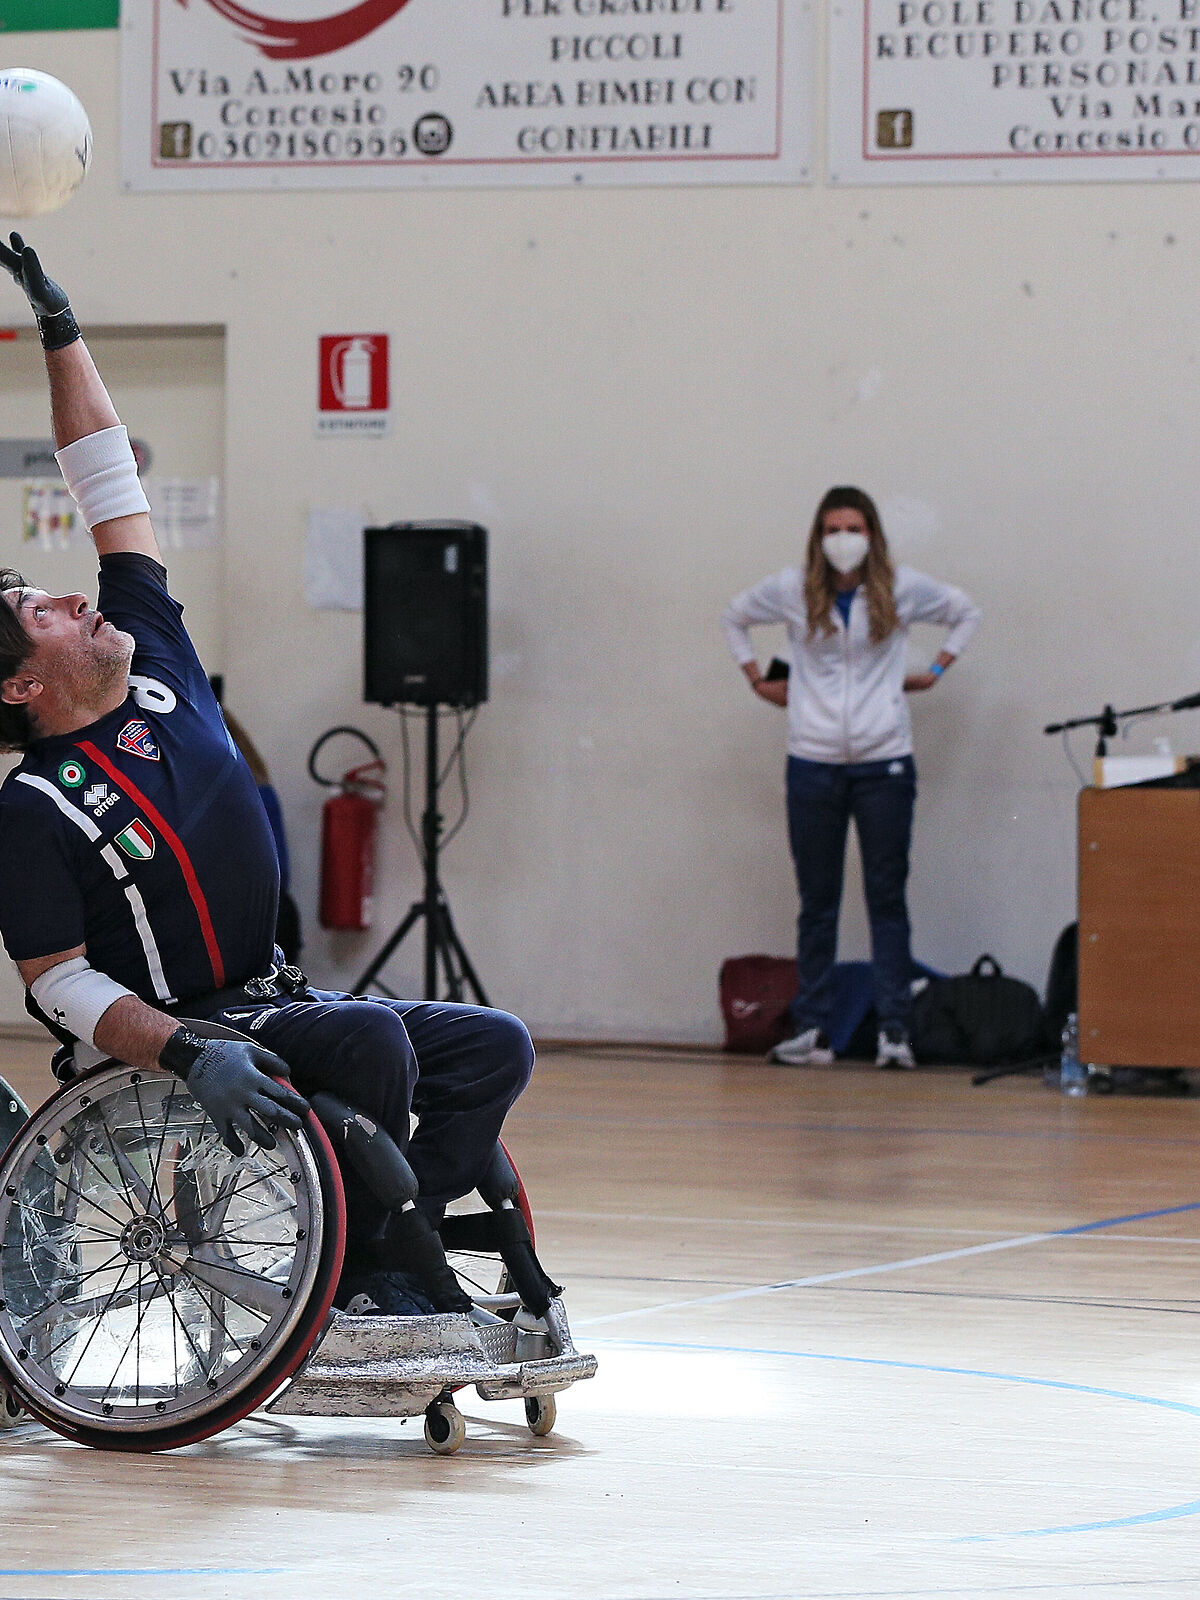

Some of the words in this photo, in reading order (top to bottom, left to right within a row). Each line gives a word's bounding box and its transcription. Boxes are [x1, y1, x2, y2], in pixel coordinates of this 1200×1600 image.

[898, 0, 990, 25] POLE
[550, 33, 683, 61] PICCOLI
[876, 30, 1084, 58] RECUPERO
[169, 68, 231, 96] Via
[475, 82, 565, 108] AREA
[576, 79, 675, 106] BIMBI
[686, 76, 758, 104] CON
[220, 98, 386, 127] Concesio
[1050, 95, 1113, 119] Via
[1008, 124, 1170, 150] Concesio
